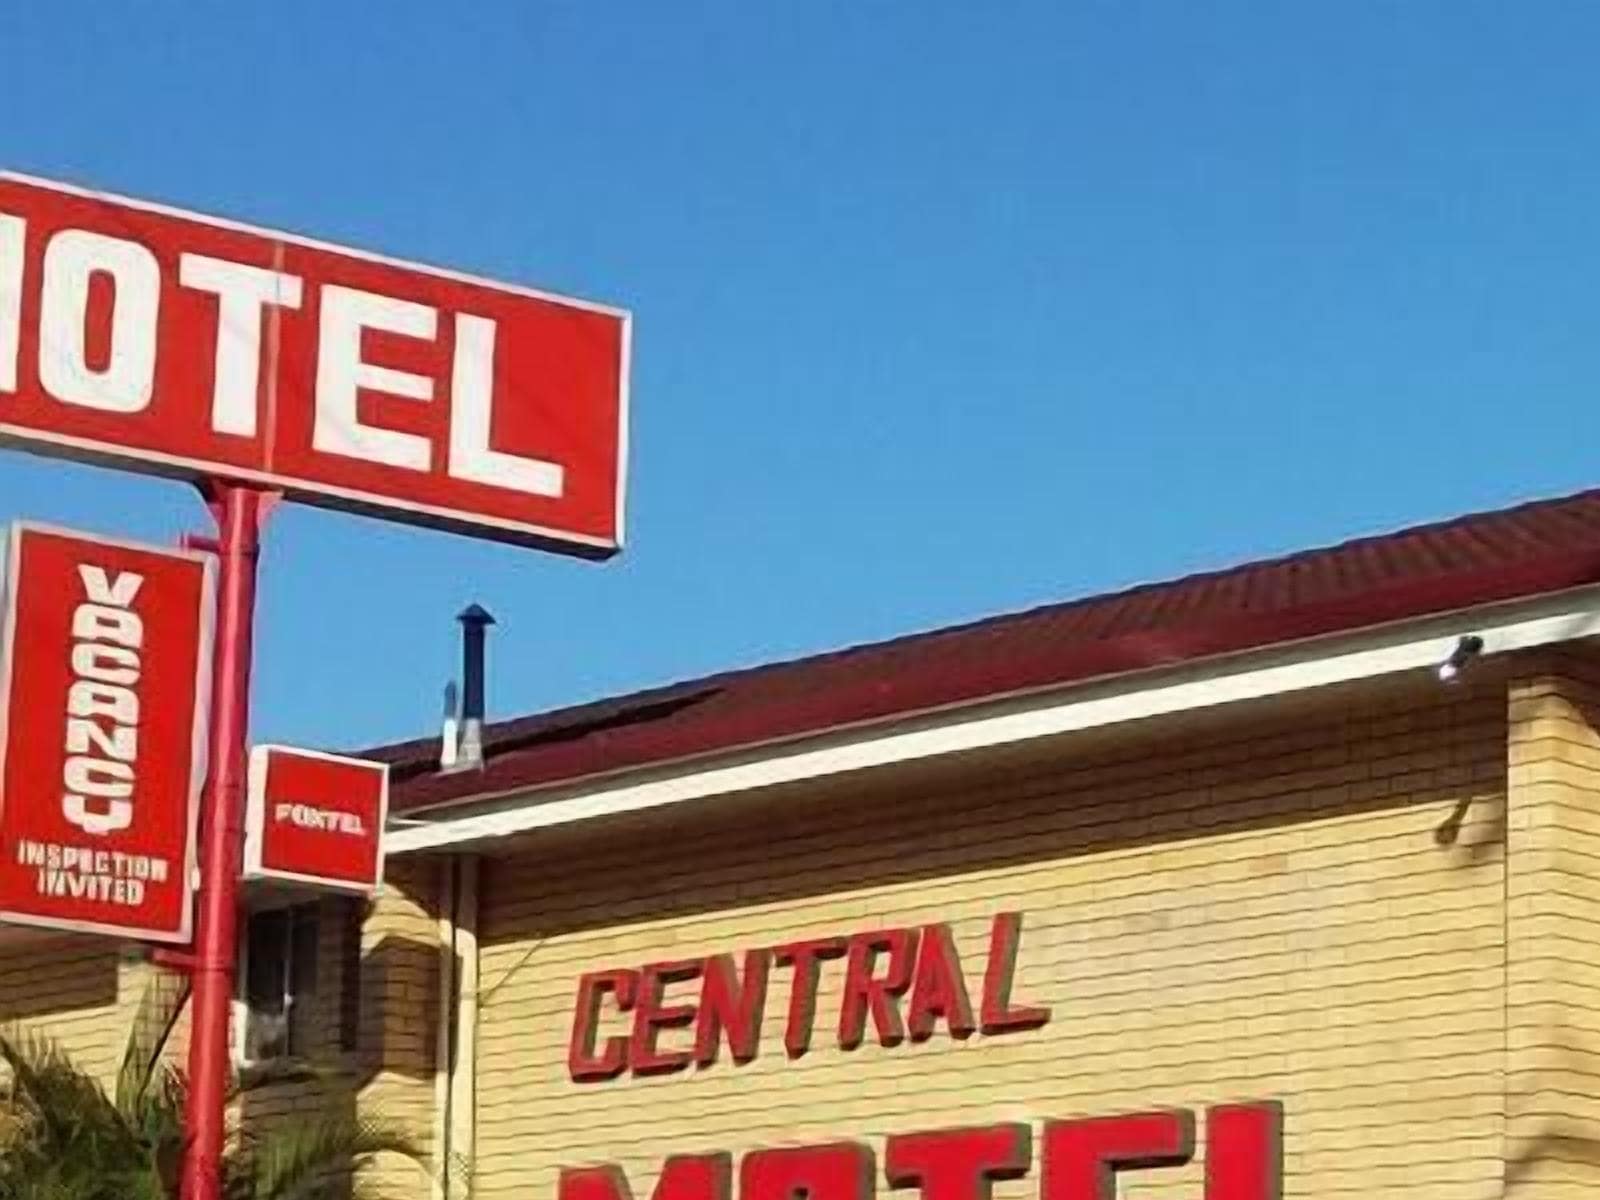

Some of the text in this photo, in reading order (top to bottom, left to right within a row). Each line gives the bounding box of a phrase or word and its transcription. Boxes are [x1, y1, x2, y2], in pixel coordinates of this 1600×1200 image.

[0, 211, 564, 499] OTEL
[62, 563, 144, 835] VACANCY
[18, 839, 168, 882] INSPECTION
[37, 868, 144, 906] INVITED
[568, 911, 1053, 1084] CENTRAL
